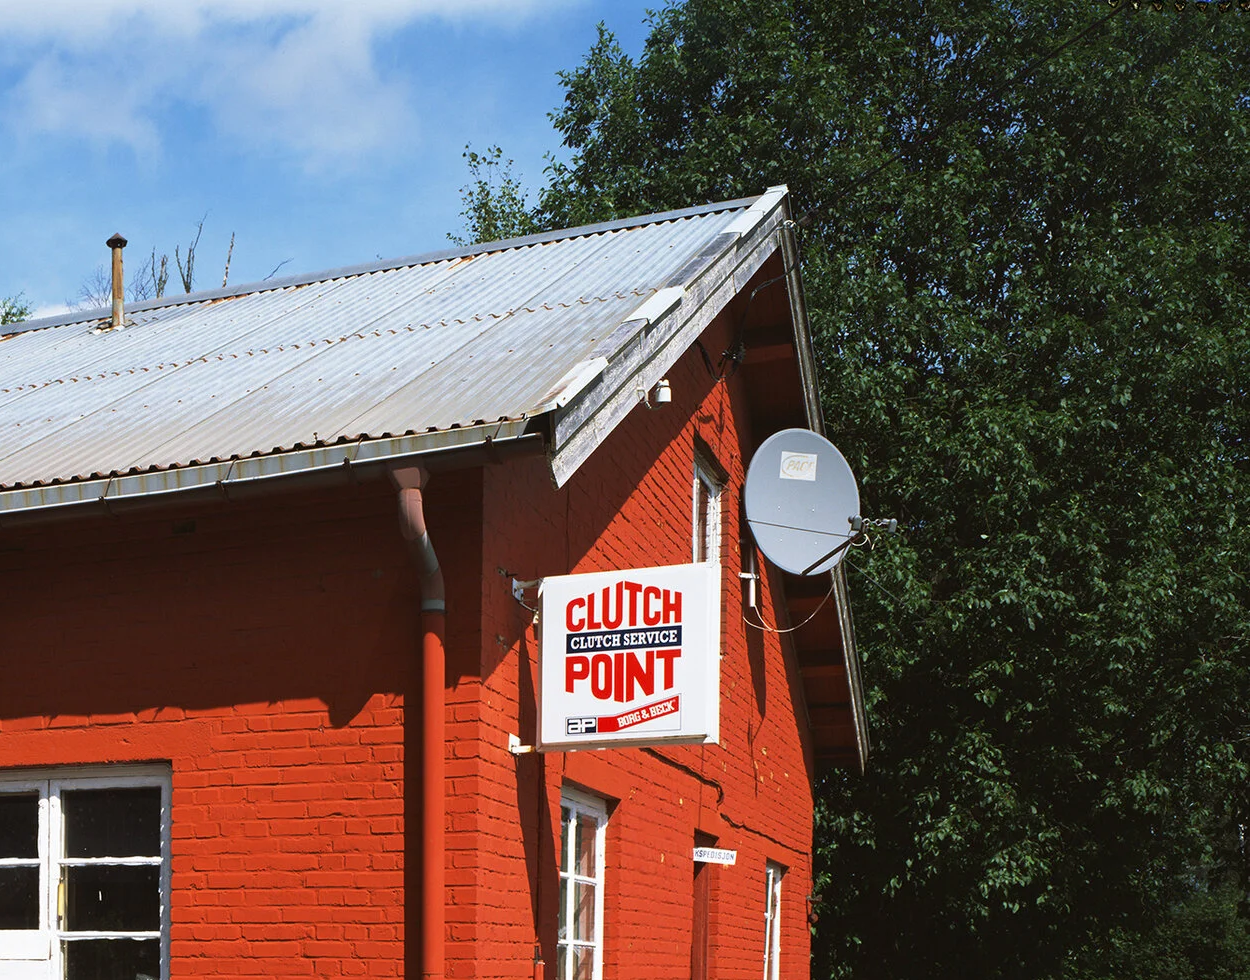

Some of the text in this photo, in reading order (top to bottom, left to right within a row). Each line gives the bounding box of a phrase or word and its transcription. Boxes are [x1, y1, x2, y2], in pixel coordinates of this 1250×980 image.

[566, 580, 682, 632] CLUTCH
[570, 630, 678, 650] CLUTCH SERVICE
[565, 649, 682, 703] POINT
[616, 700, 675, 728] BORG & BECK
[694, 849, 735, 860] KSPEDISJON
